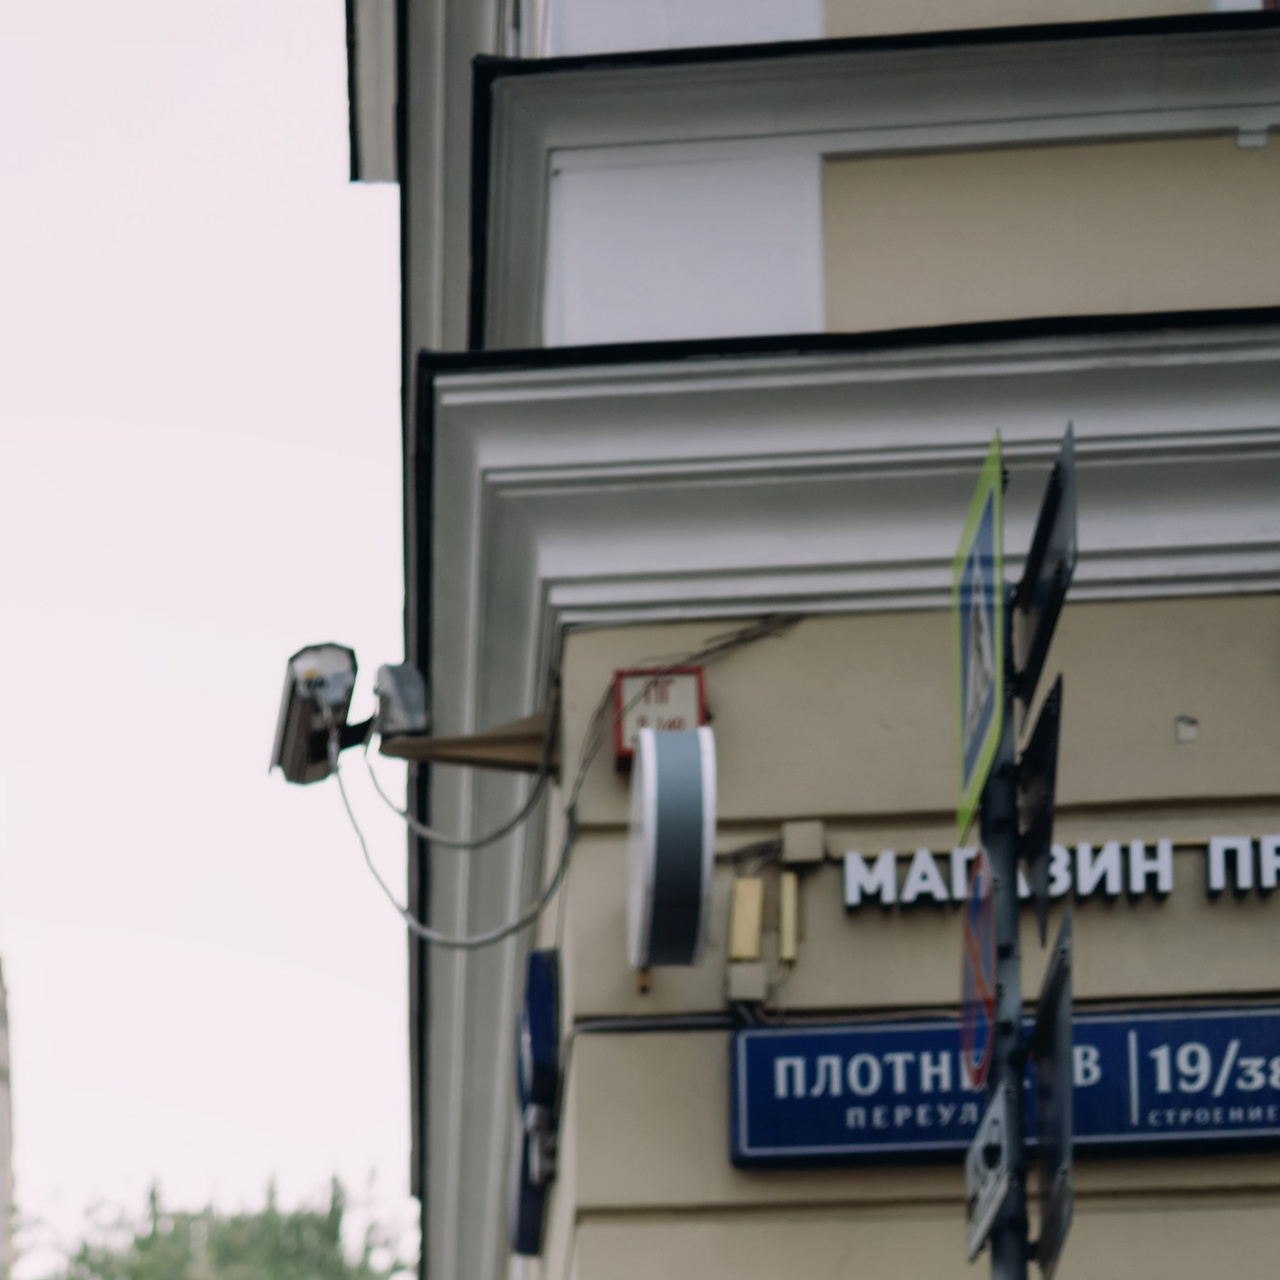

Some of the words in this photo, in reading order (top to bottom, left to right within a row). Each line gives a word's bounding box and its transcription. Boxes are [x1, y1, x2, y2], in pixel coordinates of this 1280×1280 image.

[843, 837, 1174, 906] МАГЗИН
[773, 1043, 1103, 1098] ПЛОТНВ
[844, 1101, 980, 1131] ПЕРЕУЛ
